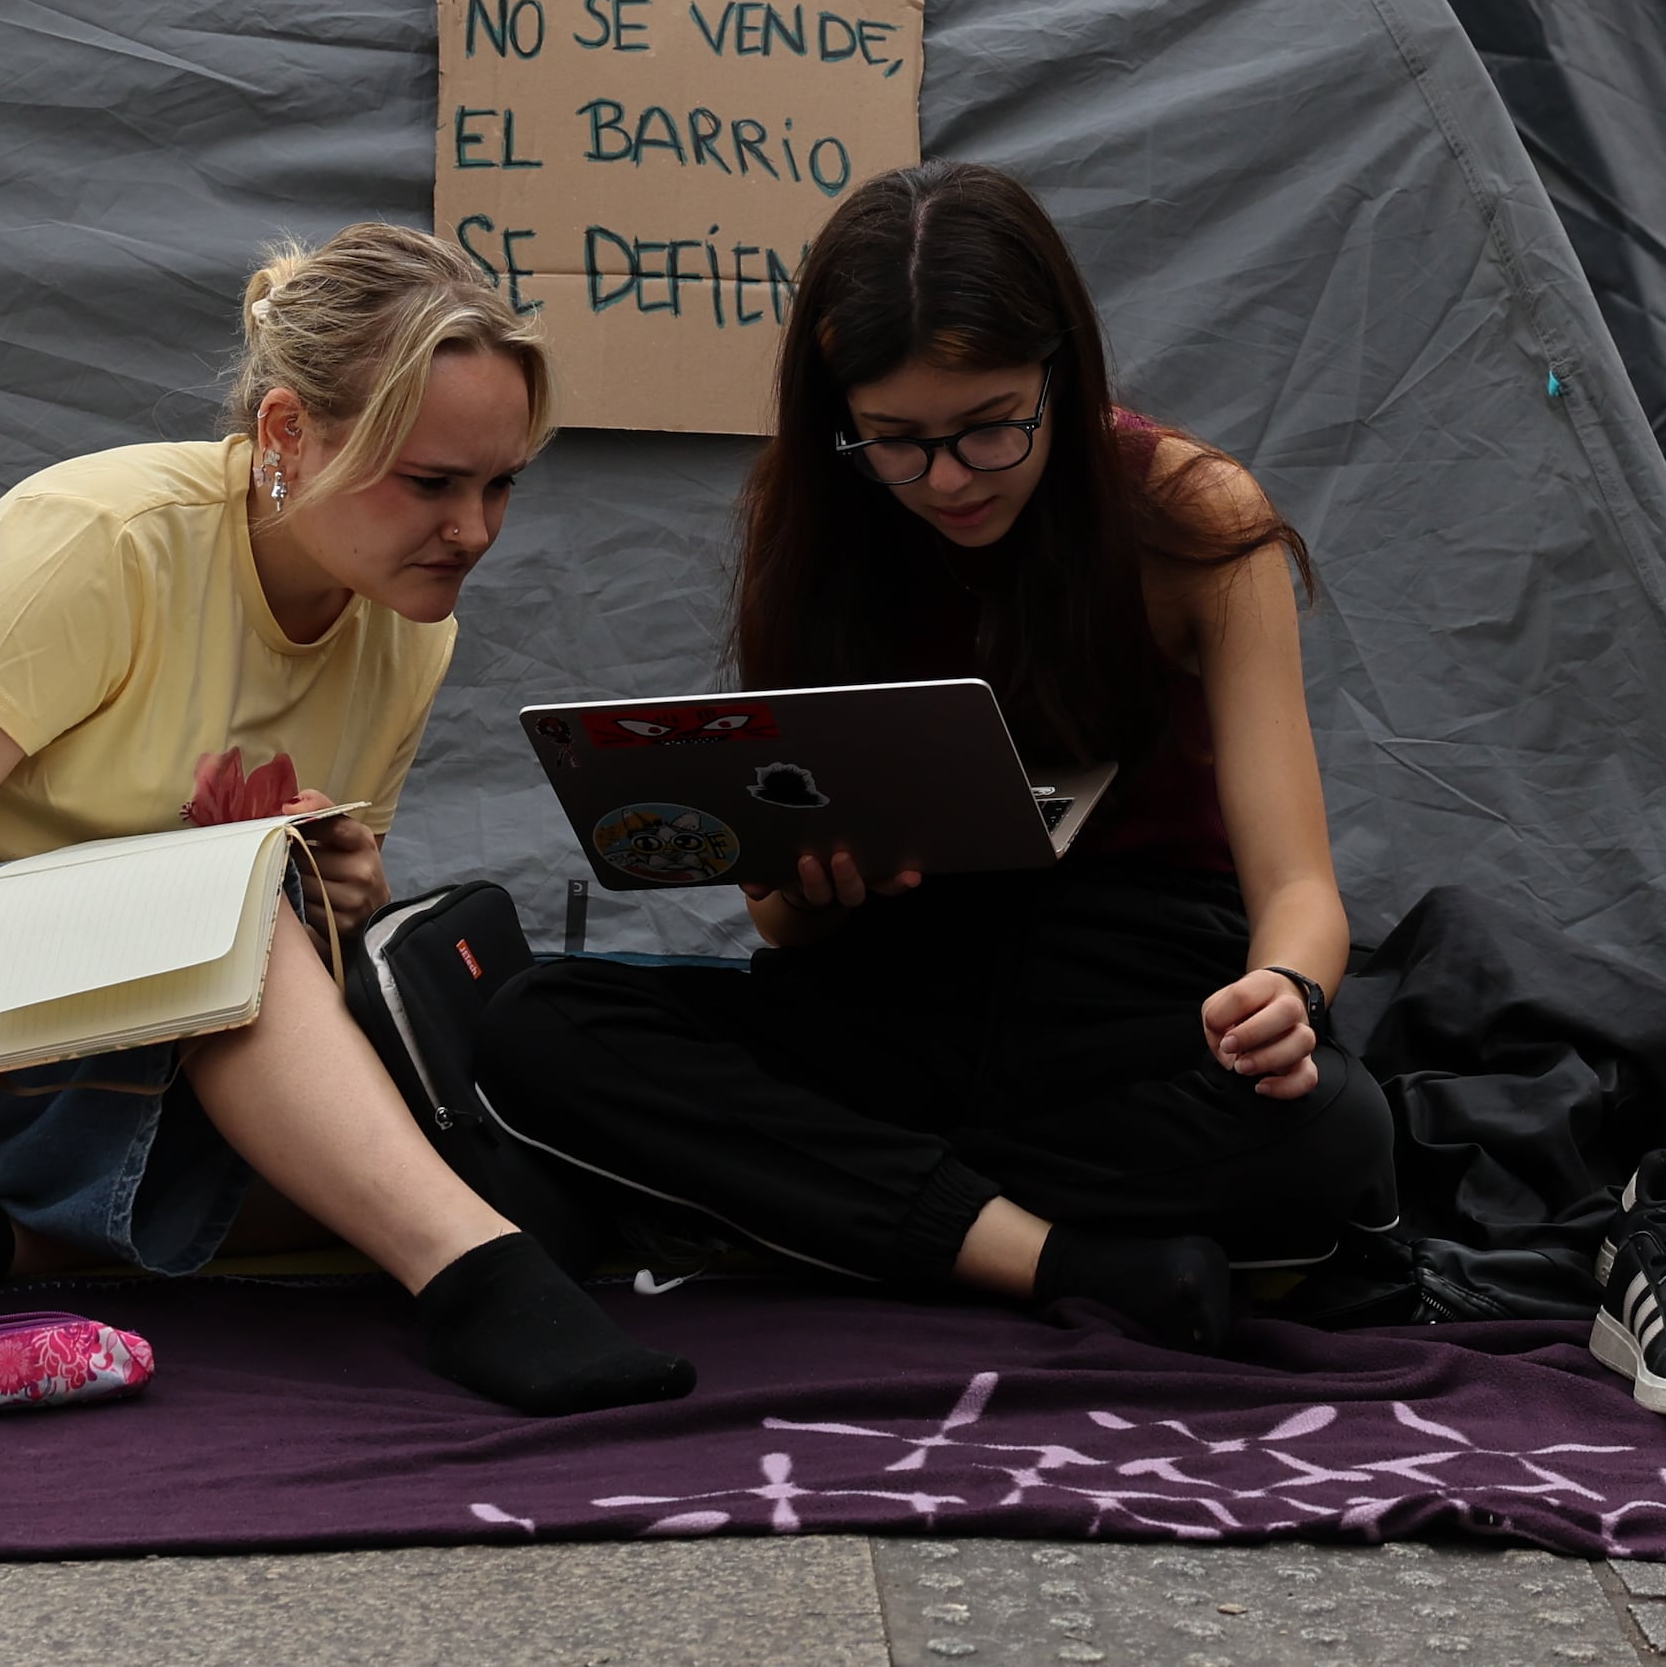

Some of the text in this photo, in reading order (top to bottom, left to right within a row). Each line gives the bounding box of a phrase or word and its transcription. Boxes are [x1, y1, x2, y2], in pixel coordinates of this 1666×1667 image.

[689, 1, 905, 78] VENDE,
[454, 105, 544, 170] EL
[456, 213, 545, 316] SE
[459, 947, 478, 975] JETech
